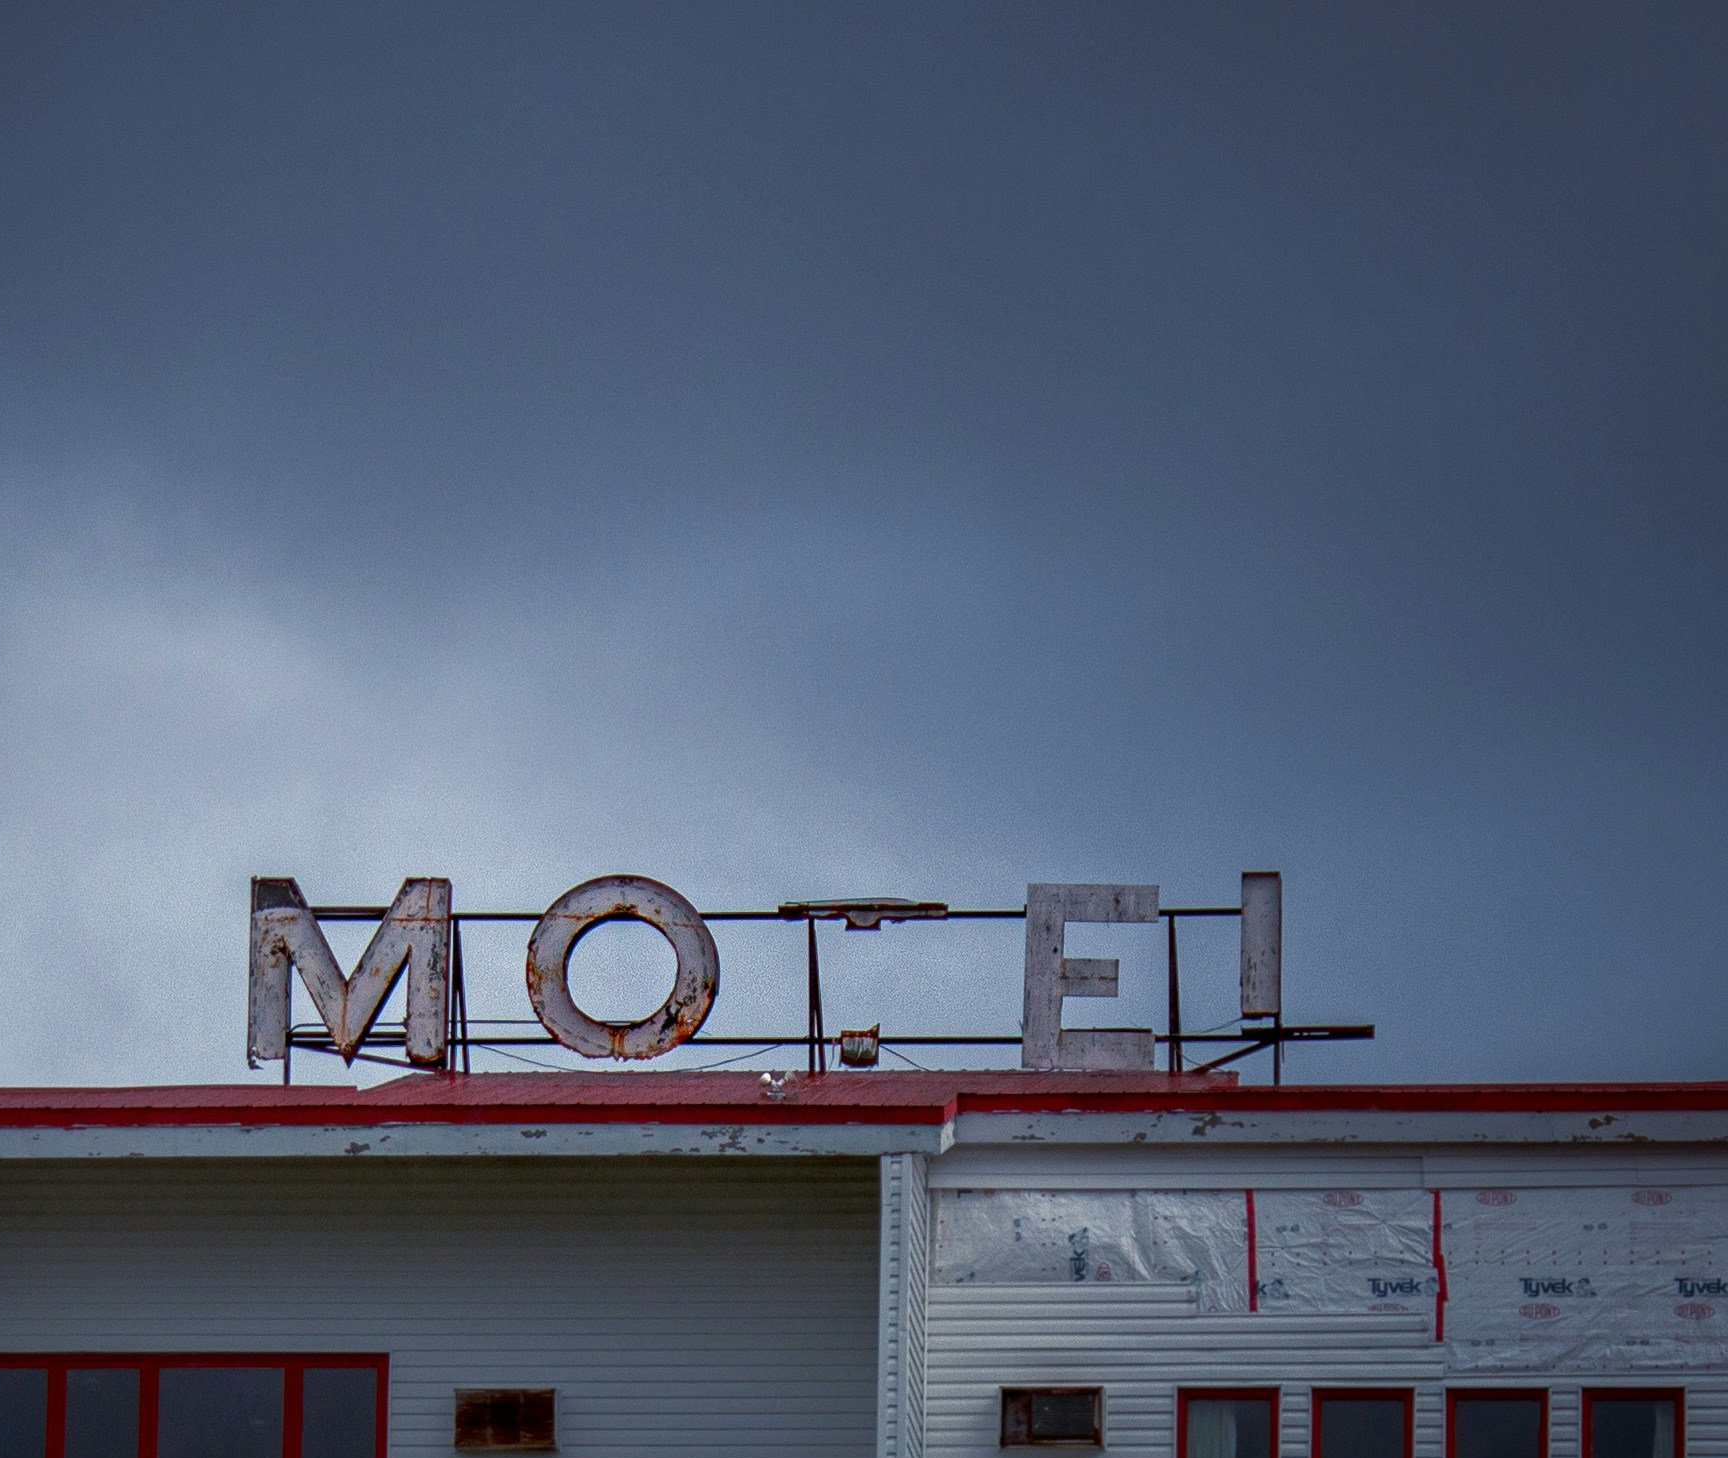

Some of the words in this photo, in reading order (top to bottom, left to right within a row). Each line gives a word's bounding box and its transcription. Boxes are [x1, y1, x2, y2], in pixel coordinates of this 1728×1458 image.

[1069, 1249, 1086, 1282] vek
[1367, 1277, 1421, 1298] Tyvek
[1519, 1277, 1574, 1298] Tyvek
[1674, 1277, 1728, 1298] Tyvek
